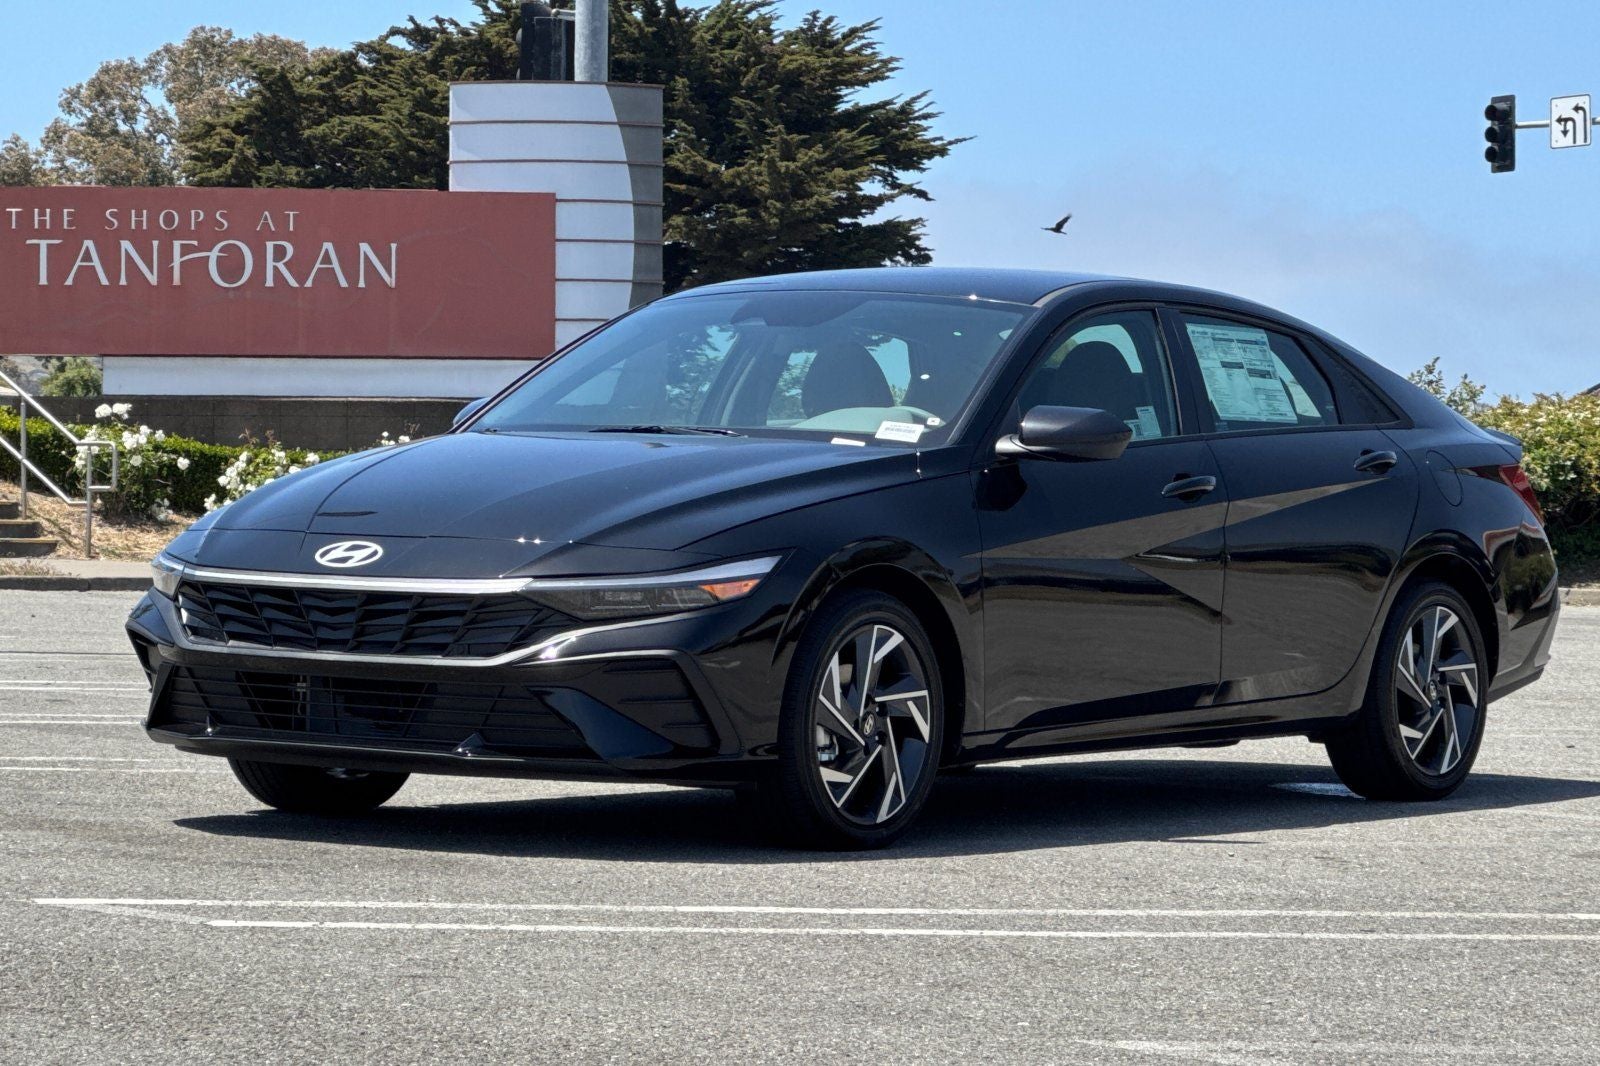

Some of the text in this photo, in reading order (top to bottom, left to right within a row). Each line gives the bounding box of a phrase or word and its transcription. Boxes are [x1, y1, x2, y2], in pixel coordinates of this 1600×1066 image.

[5, 207, 300, 232] THE SHOPS AT
[25, 238, 398, 289] TANFORAN
